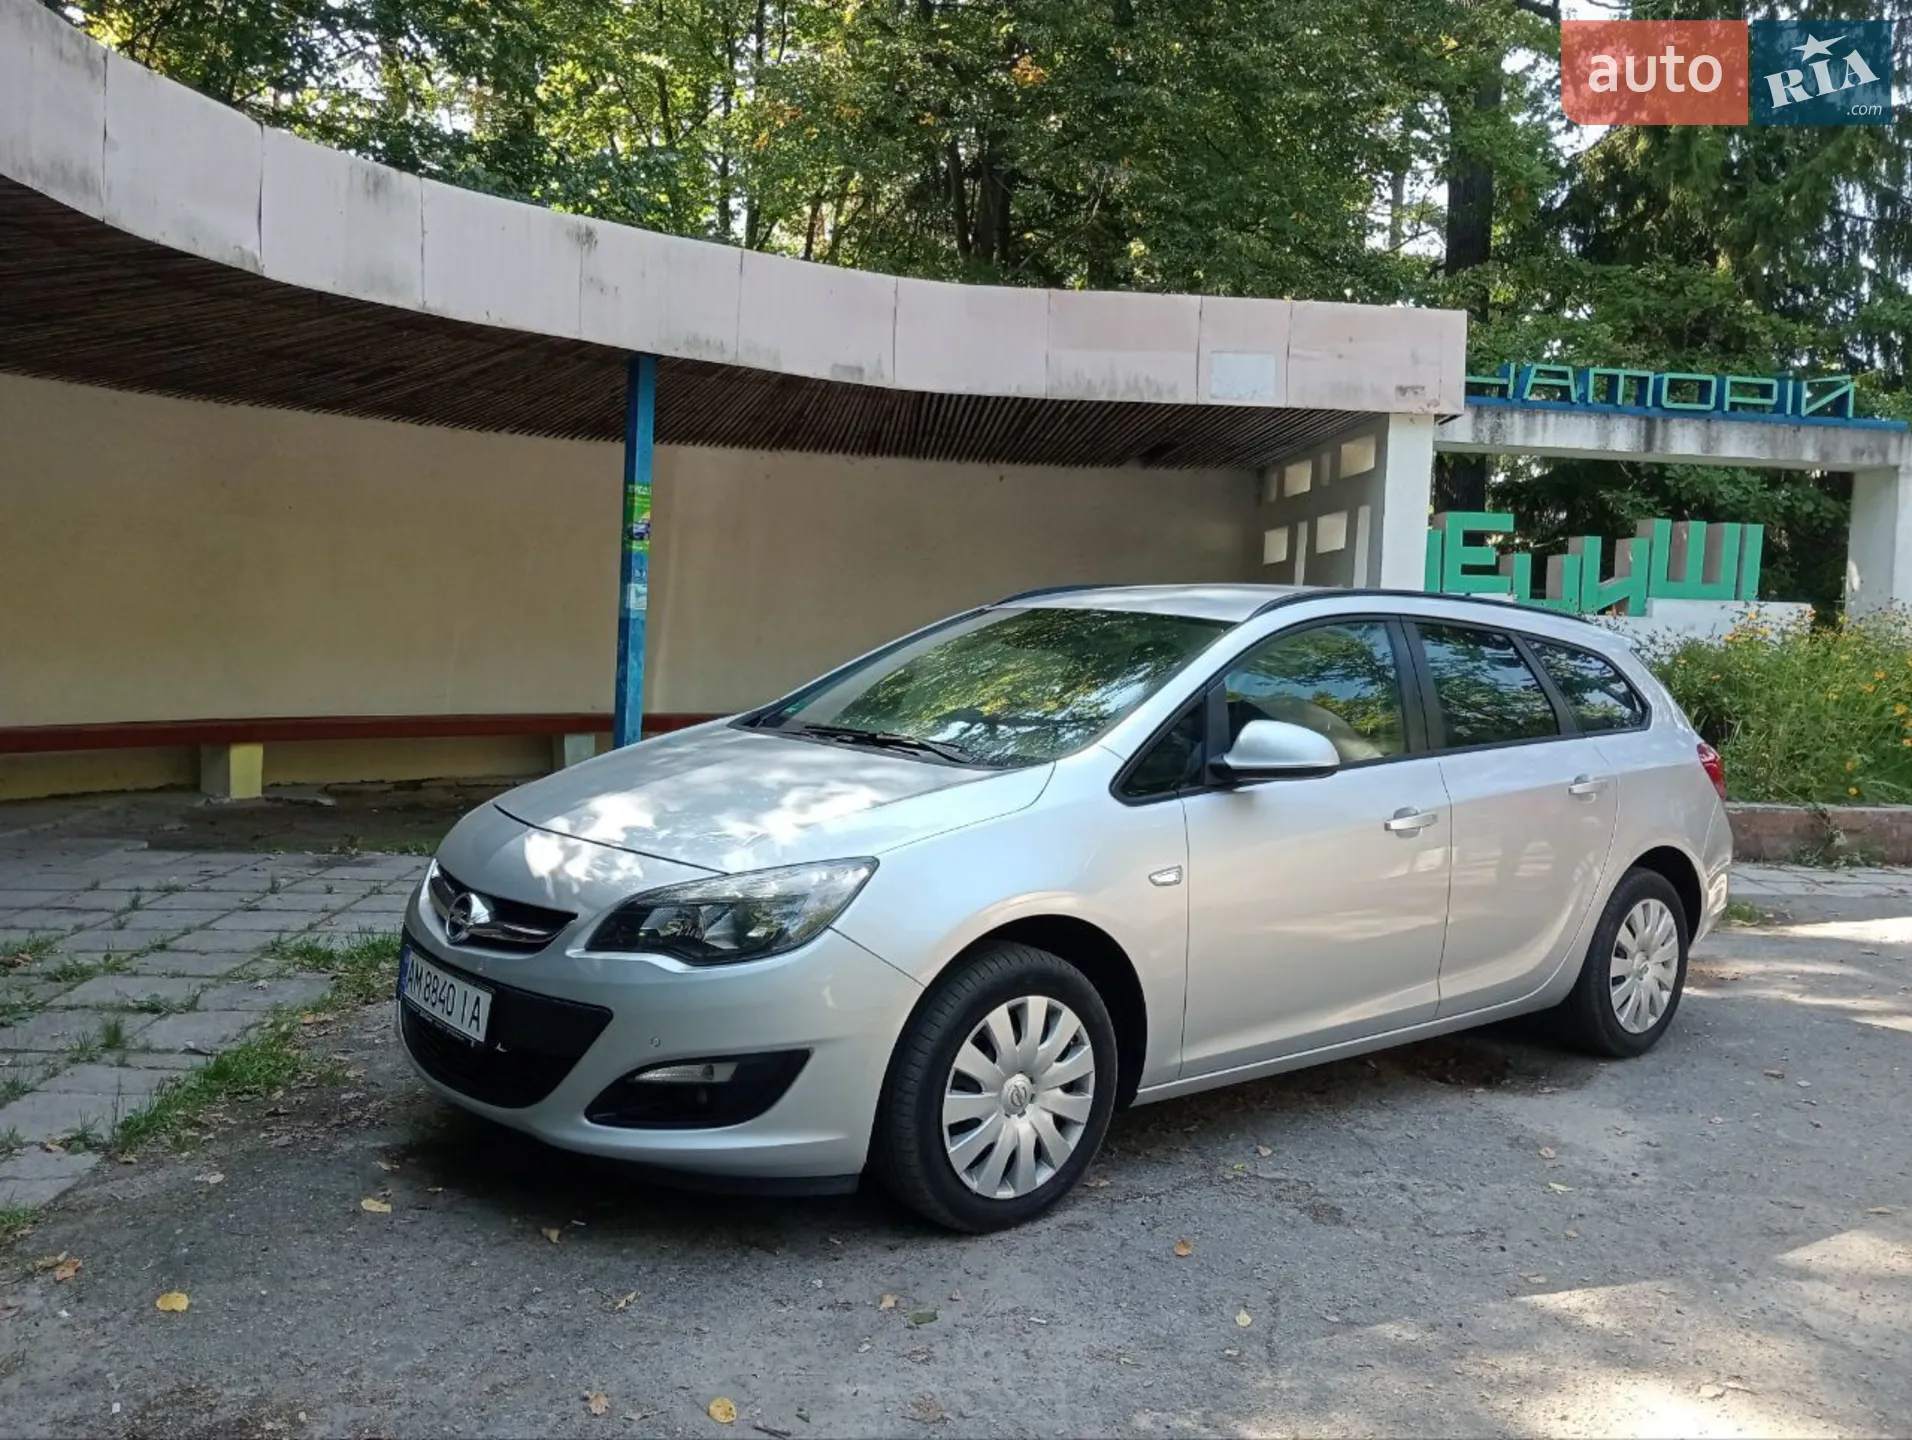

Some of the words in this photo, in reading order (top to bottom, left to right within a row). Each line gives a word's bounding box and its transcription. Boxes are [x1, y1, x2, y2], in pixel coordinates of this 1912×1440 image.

[406, 958, 424, 999] AM
[423, 970, 456, 1017] 8840
[460, 990, 481, 1033] IA
